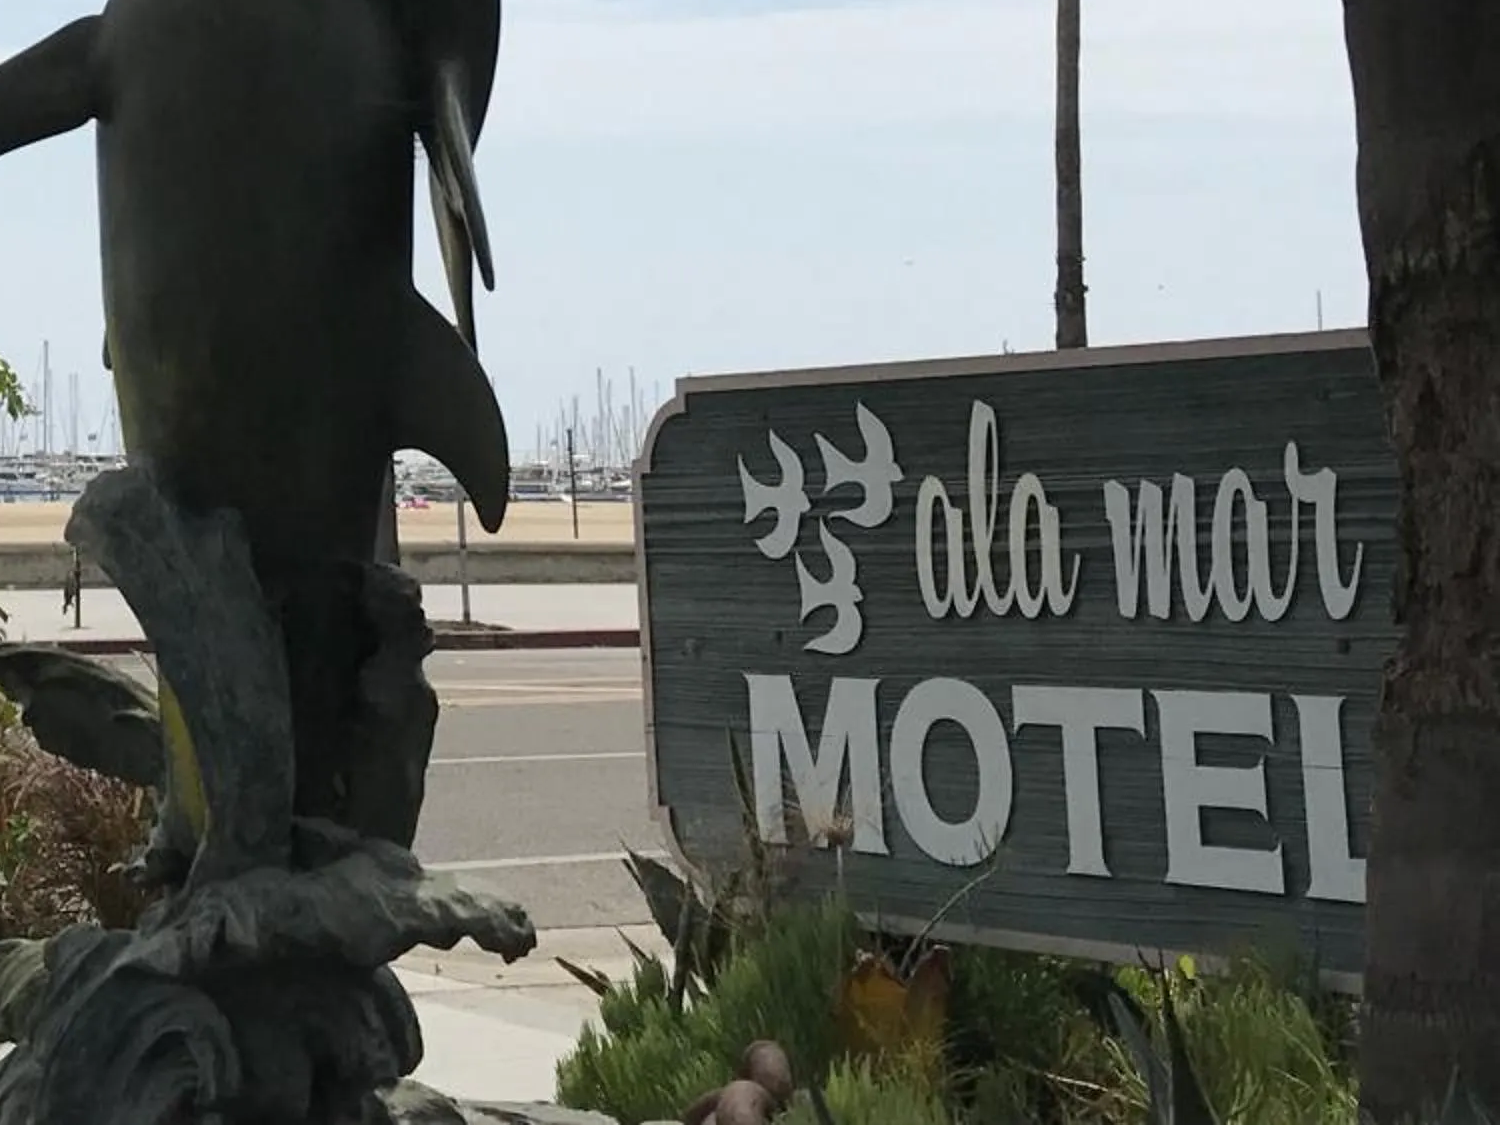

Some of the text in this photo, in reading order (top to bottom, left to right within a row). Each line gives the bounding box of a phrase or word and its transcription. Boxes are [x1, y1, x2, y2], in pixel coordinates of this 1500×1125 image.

[914, 398, 1364, 624] ala mar
[743, 671, 1367, 904] MOTEL
